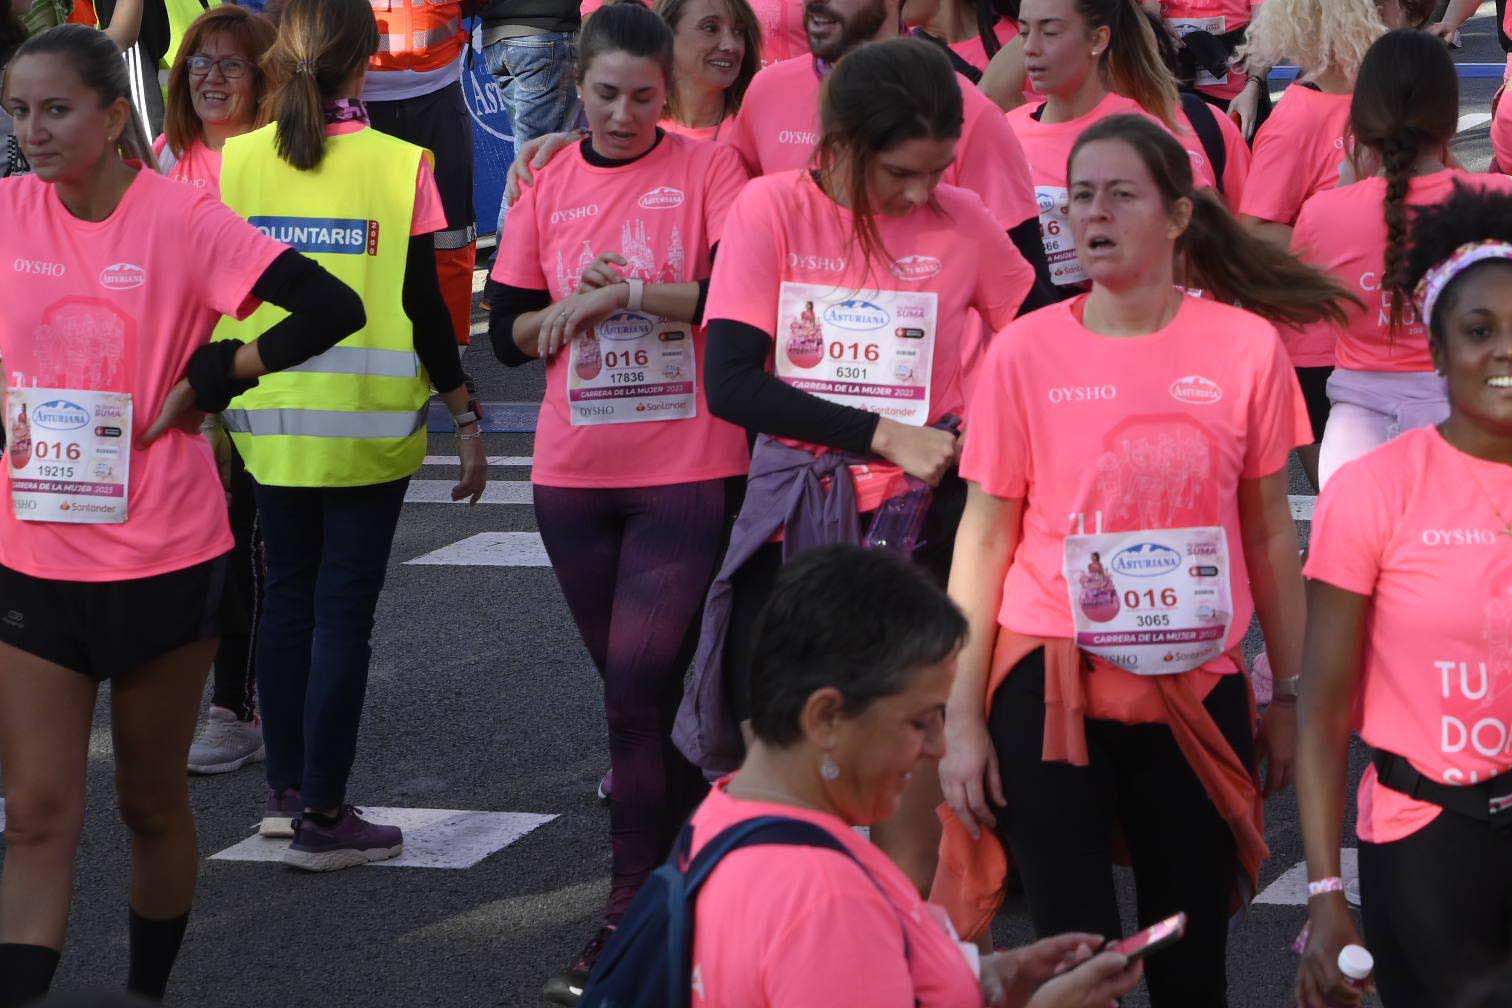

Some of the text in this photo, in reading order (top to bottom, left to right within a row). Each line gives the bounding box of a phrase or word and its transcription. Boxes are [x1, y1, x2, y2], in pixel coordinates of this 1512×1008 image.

[551, 204, 599, 225] OYSHO
[256, 221, 377, 255] OLUNTARIS 2000
[13, 258, 66, 278] OYSHO
[788, 252, 845, 272] OYSHO
[829, 309, 884, 325] ASTURIANA
[605, 349, 648, 368] 016
[829, 340, 881, 362] 016
[610, 371, 645, 384] 17836
[836, 366, 868, 380] 6301
[581, 388, 613, 399] CARRERA
[614, 388, 624, 397] DE
[625, 387, 636, 395] LA
[792, 380, 833, 392] CARRERA
[835, 383, 848, 393] DE
[848, 385, 861, 394] LA
[861, 386, 893, 396] MUJER
[1049, 384, 1117, 404] OYSHO
[580, 405, 614, 417] OYSHO
[646, 400, 688, 412] Santander
[869, 405, 917, 418] Santander
[35, 410, 86, 424] ASTURIANA
[35, 440, 82, 460] 016
[37, 465, 75, 478] 19215
[39, 482, 51, 491] DE
[51, 483, 63, 492] LA
[63, 483, 92, 493] MUJER
[71, 501, 117, 514] Santander
[1421, 527, 1497, 547] OYSHO
[1117, 556, 1177, 570] ASTURIANA
[1123, 587, 1178, 609] 016
[1136, 614, 1171, 628] 3065
[1093, 633, 1137, 644] CARRERA
[1138, 634, 1150, 642] DE
[1152, 632, 1164, 641] LA
[1166, 630, 1197, 641] MUJER
[1434, 660, 1488, 701] TU
